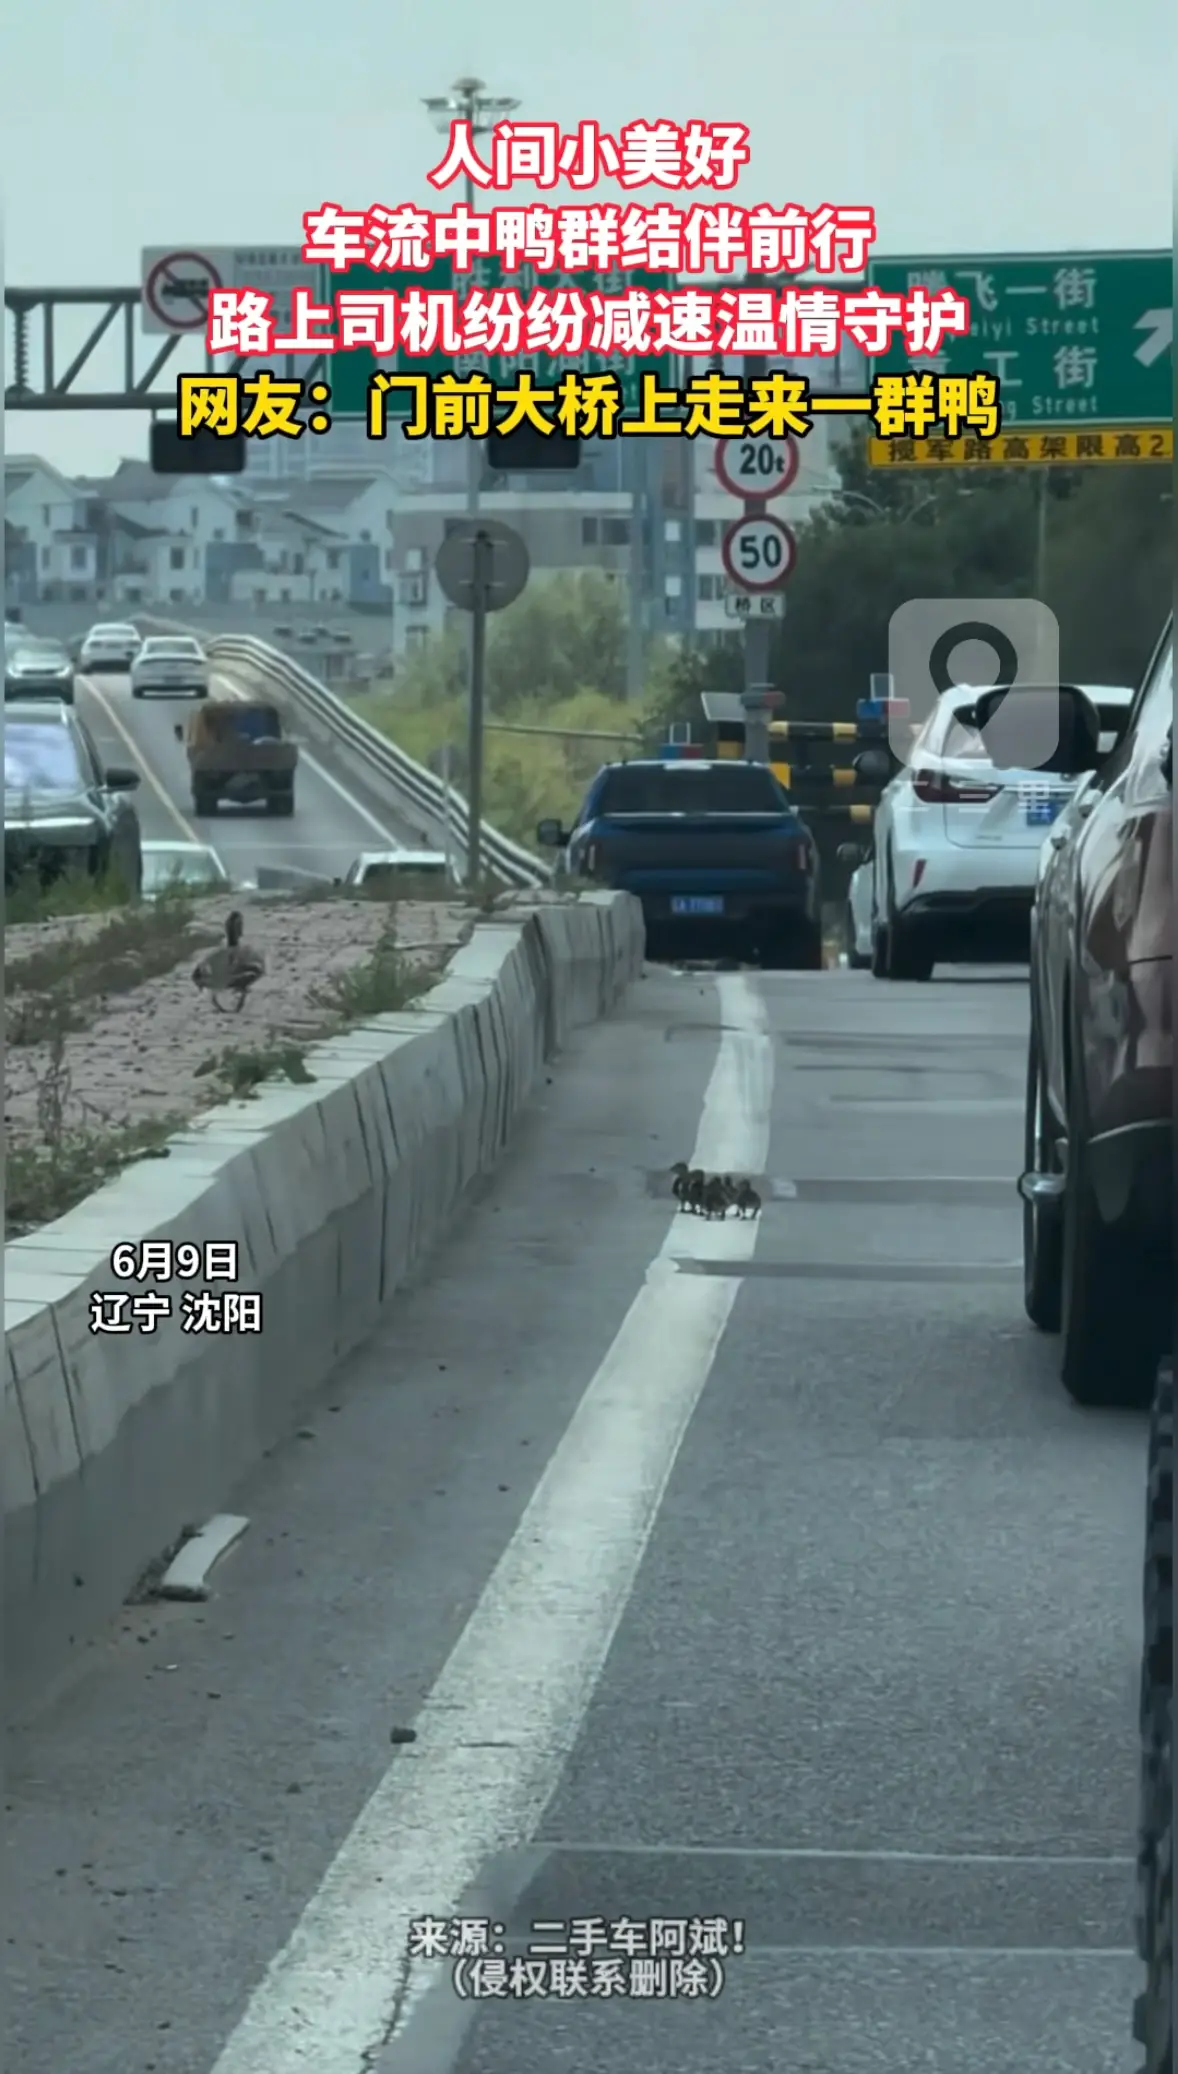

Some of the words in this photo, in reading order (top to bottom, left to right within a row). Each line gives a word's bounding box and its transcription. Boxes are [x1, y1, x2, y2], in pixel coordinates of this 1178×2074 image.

[1026, 316, 1100, 336] Street
[1031, 395, 1098, 416] Street
[739, 443, 786, 476] 20t
[739, 534, 783, 569] 50
